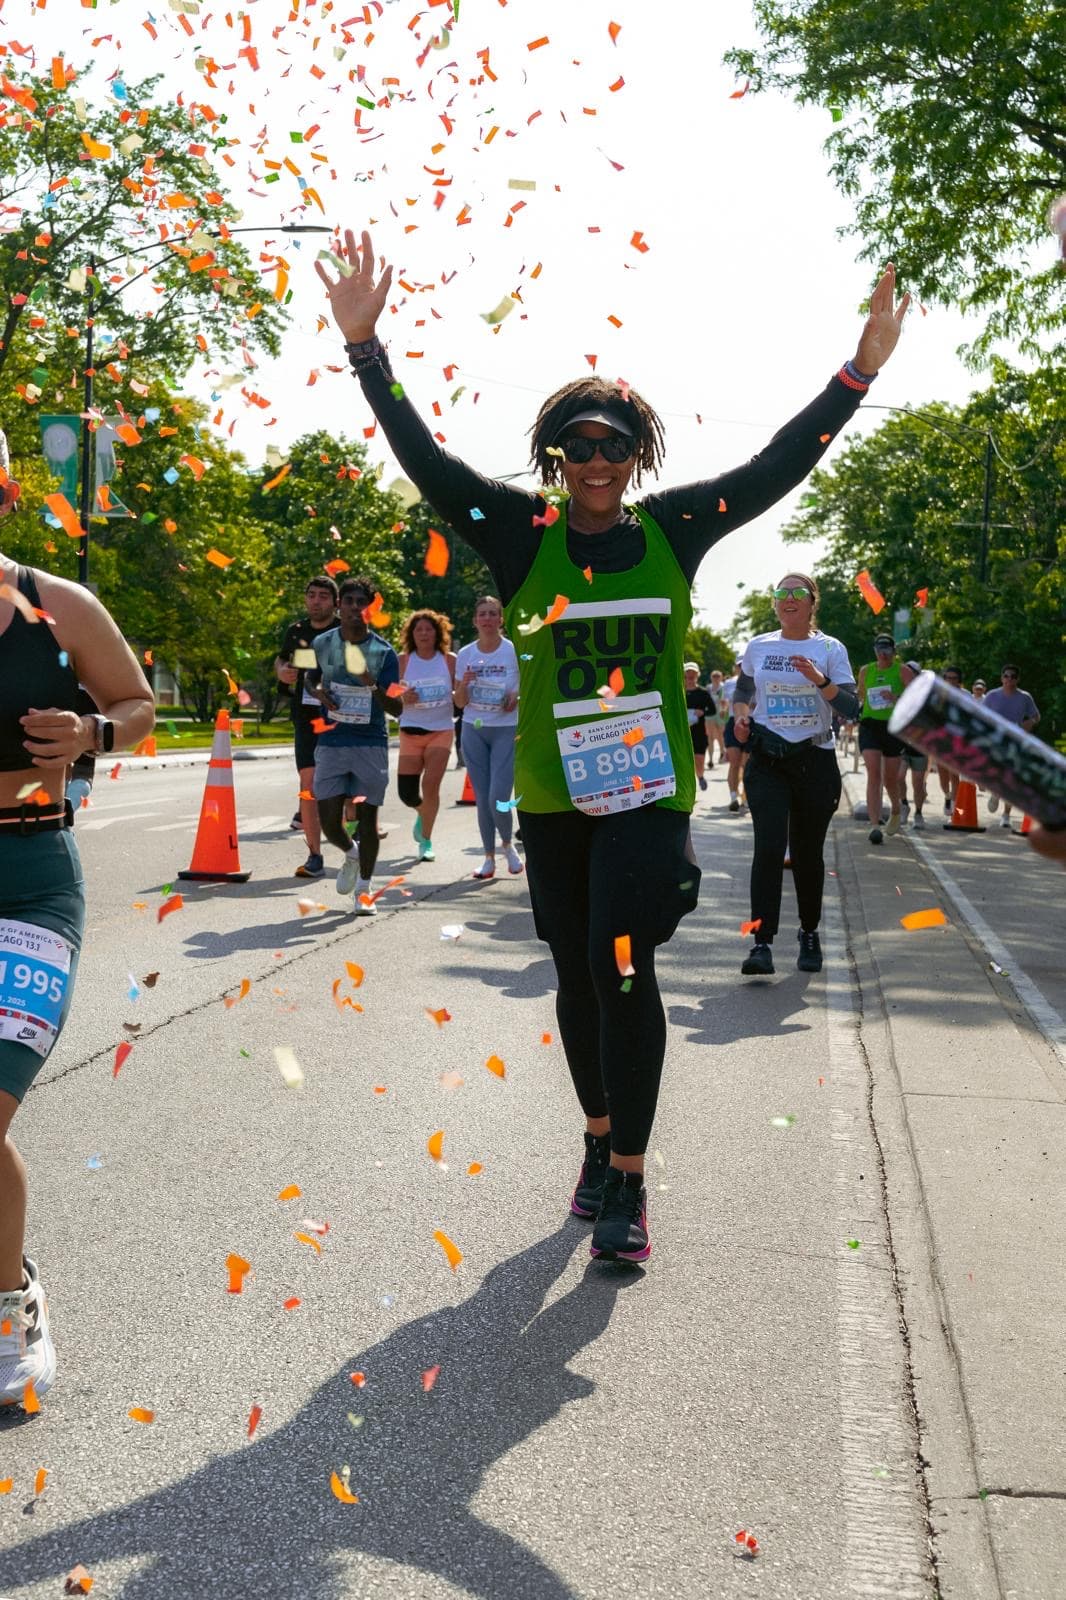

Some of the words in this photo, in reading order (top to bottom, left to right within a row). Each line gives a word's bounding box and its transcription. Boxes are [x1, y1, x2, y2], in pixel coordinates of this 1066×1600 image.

[551, 616, 669, 659] RUN
[768, 697, 777, 708] D
[780, 696, 816, 708] 11713
[588, 726, 605, 734] BANK
[613, 719, 641, 728] AMERICA
[589, 730, 620, 743] CHICAGO
[567, 759, 588, 782] B
[596, 739, 667, 776] 8904
[19, 931, 52, 944] AMERICA
[26, 940, 40, 951] 13.1
